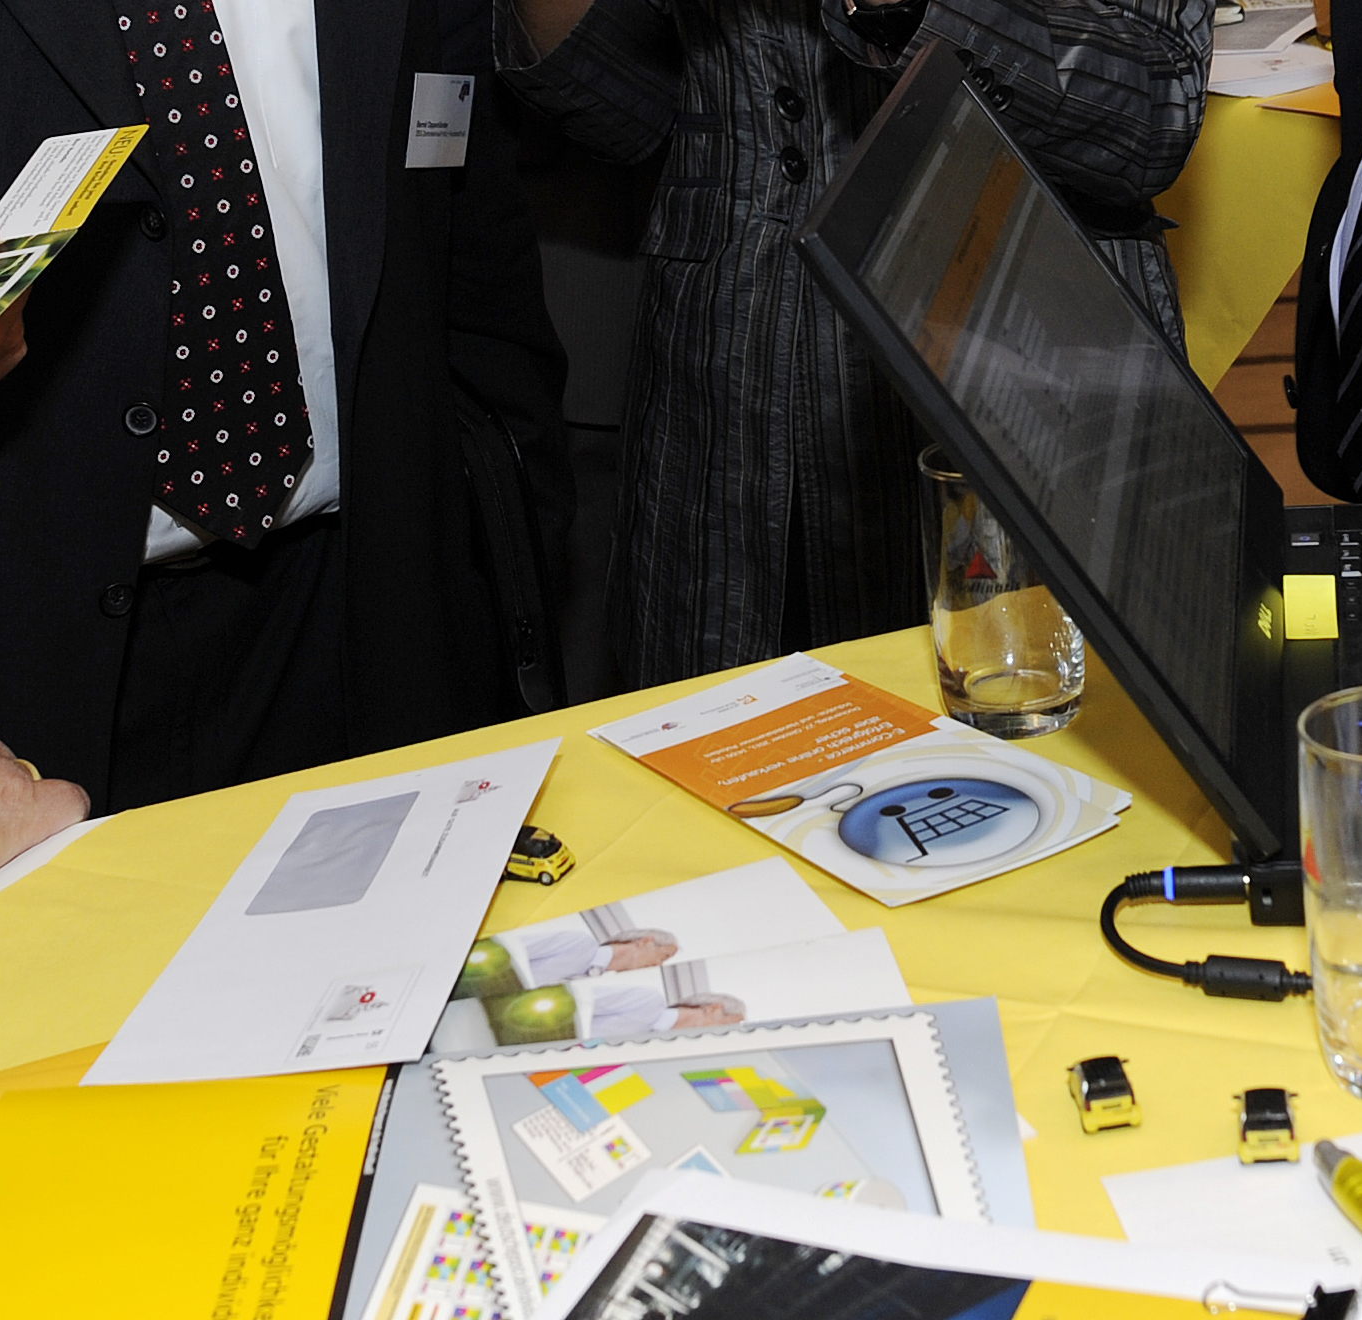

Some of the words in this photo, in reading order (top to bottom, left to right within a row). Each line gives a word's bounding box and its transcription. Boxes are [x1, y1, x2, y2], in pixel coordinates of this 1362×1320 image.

[816, 727, 851, 743] sicher
[826, 728, 905, 759] E-Commerce
[827, 722, 893, 748] Erfolgreich
[787, 747, 825, 763] online
[308, 1084, 340, 1120] Viele
[260, 1135, 288, 1160] für
[247, 1165, 280, 1199] Ihre
[231, 1203, 261, 1248] ganz
